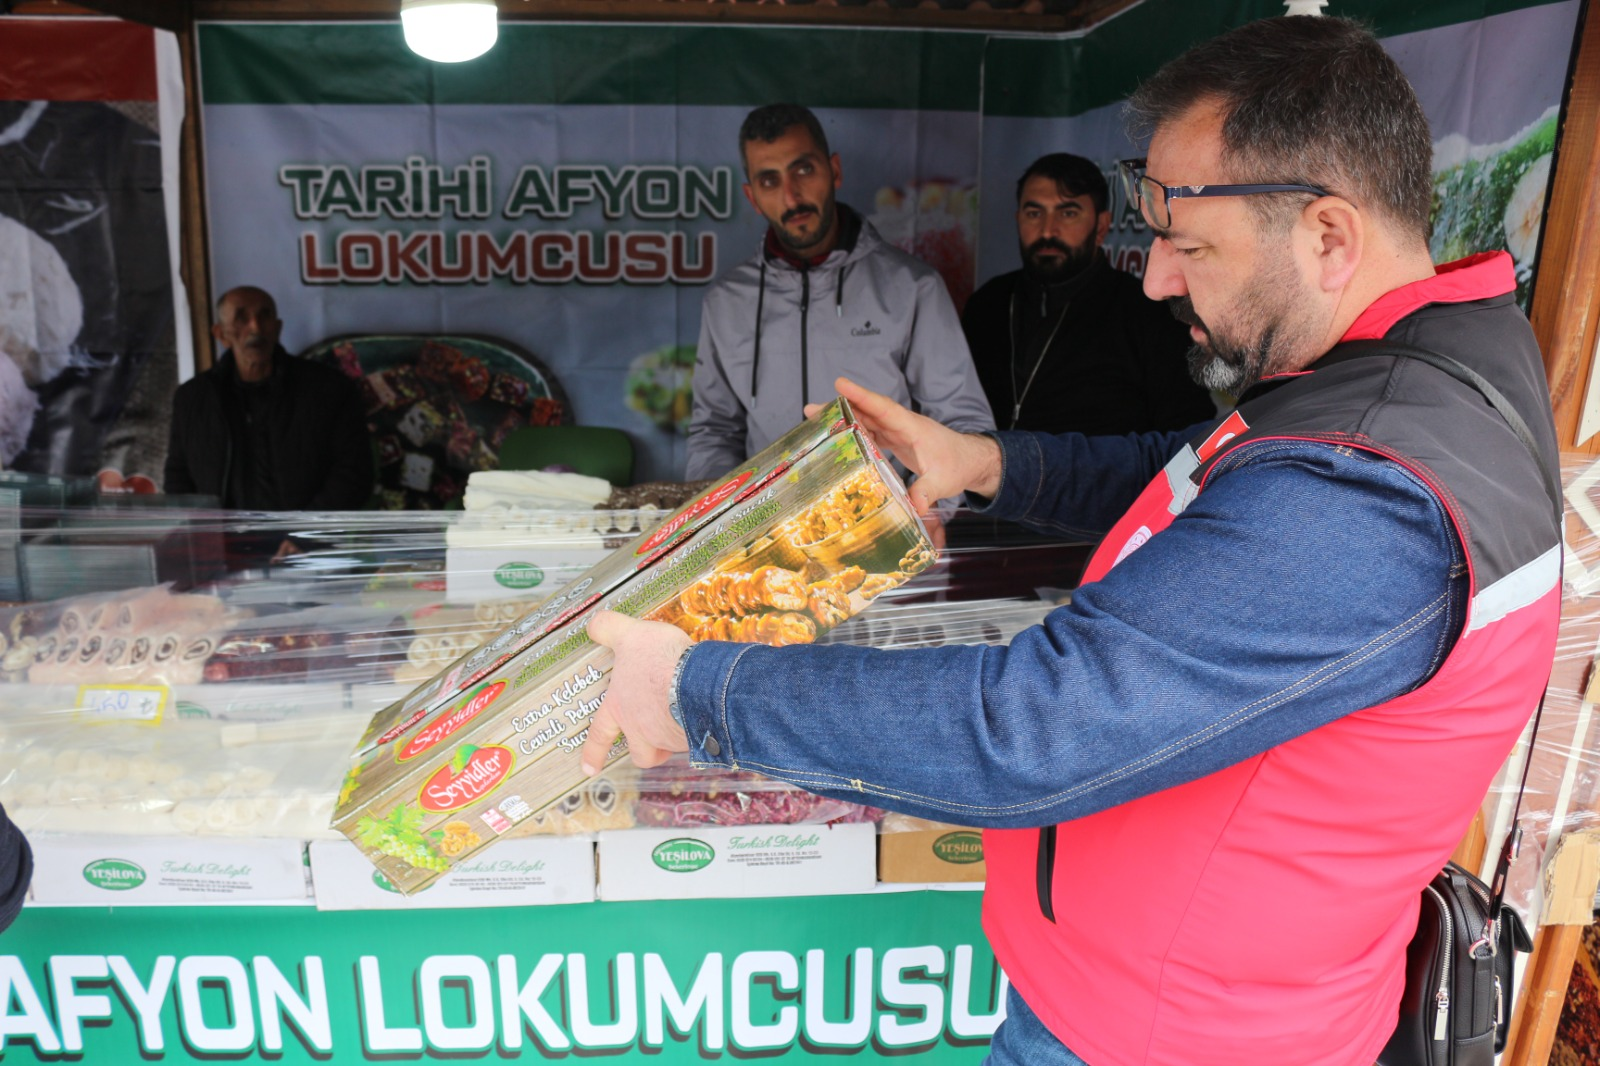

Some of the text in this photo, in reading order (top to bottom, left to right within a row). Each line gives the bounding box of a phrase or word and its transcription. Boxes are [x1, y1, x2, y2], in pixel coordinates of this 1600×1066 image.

[280, 156, 732, 219] TARİHİ AFYON
[300, 231, 716, 284] LOKUMCUSU
[511, 703, 553, 733] Extra
[551, 665, 603, 707] Kelebek
[410, 690, 495, 754] Seyyidler
[520, 719, 566, 755] Cevizli
[427, 755, 501, 807] Seyyidler
[660, 849, 711, 865] YEŞİLOVA
[728, 833, 820, 850] Turkish Delight
[940, 841, 983, 856] YEŞİLOV
[91, 867, 144, 881] YEŞİLOVA
[160, 860, 252, 879] Turkish Delight
[498, 860, 545, 875] Delight
[0, 954, 334, 1052] AFYON
[357, 944, 1009, 1053] LOKUMCUSU
